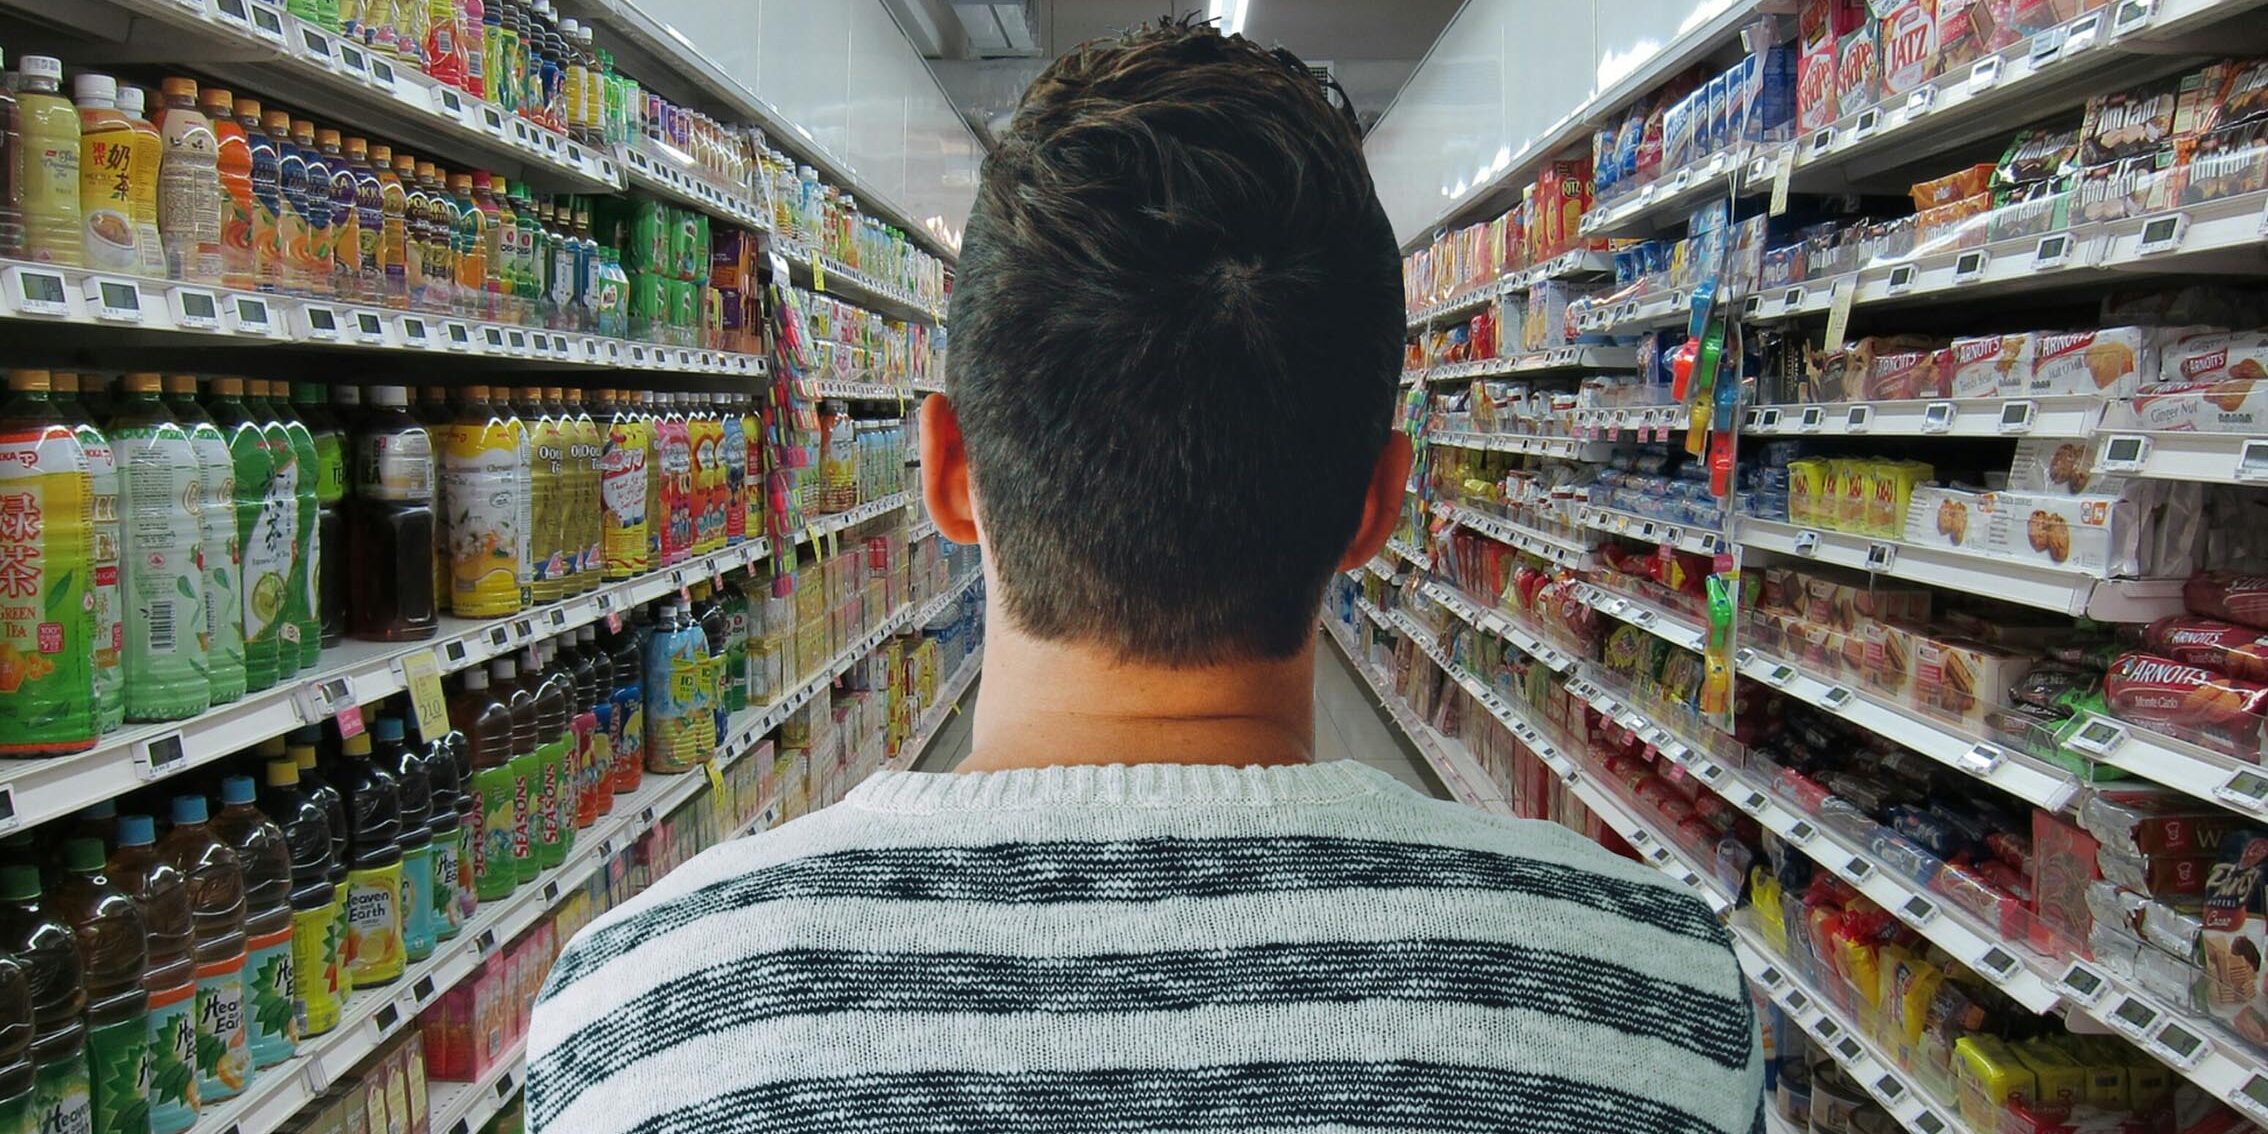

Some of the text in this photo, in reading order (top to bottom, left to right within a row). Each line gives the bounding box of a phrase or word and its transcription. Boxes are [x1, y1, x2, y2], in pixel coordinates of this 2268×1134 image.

[1889, 24, 1928, 76] JATZ
[1562, 180, 1582, 197] RITZ
[2151, 401, 2198, 422] Ginger Nut
[2135, 696, 2178, 708] Monte Carlo
[543, 762, 558, 845] SEASONS
[514, 775, 529, 858] SEASONS
[349, 904, 386, 922] Earth
